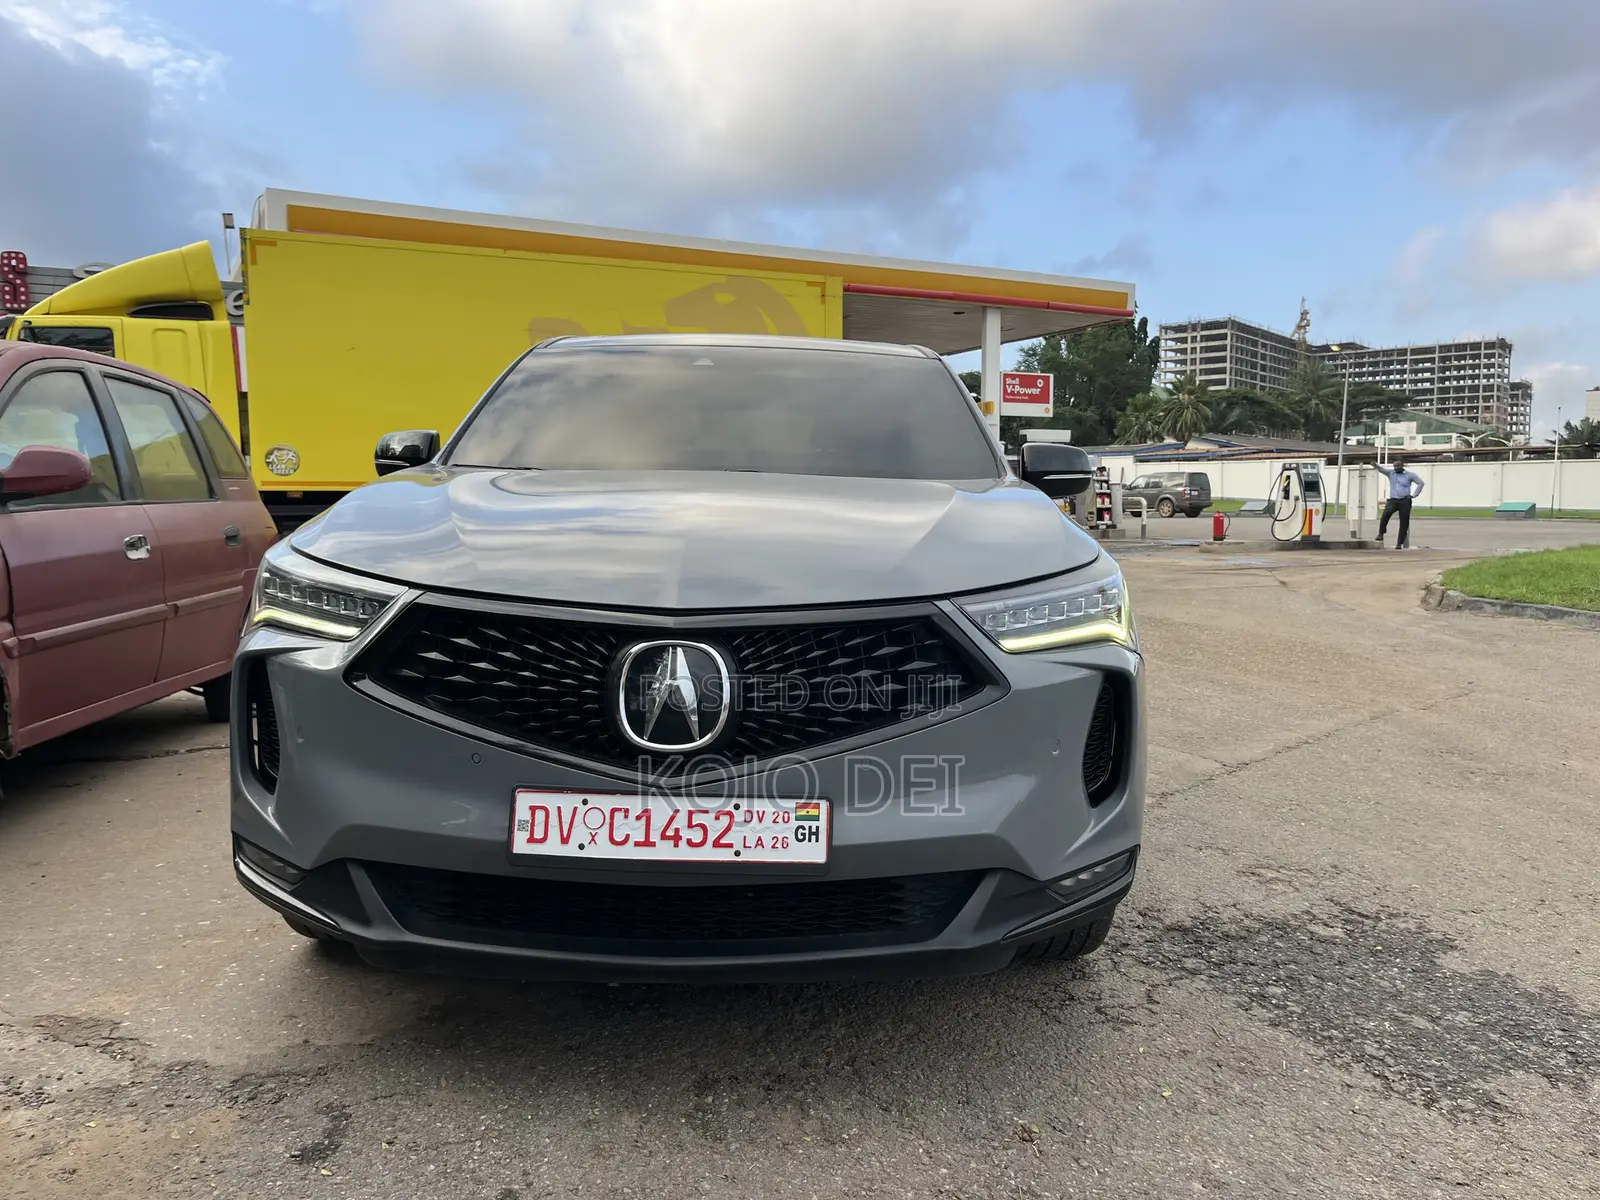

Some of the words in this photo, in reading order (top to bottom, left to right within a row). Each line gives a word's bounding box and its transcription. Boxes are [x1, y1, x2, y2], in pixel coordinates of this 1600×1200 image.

[1006, 385, 1041, 394] V-Power
[743, 809, 767, 825] DV
[772, 810, 792, 824] 20
[526, 805, 579, 846] DV
[608, 806, 736, 849] C1452
[794, 824, 821, 843] GH
[742, 835, 766, 849] LA
[771, 835, 790, 849] 26
